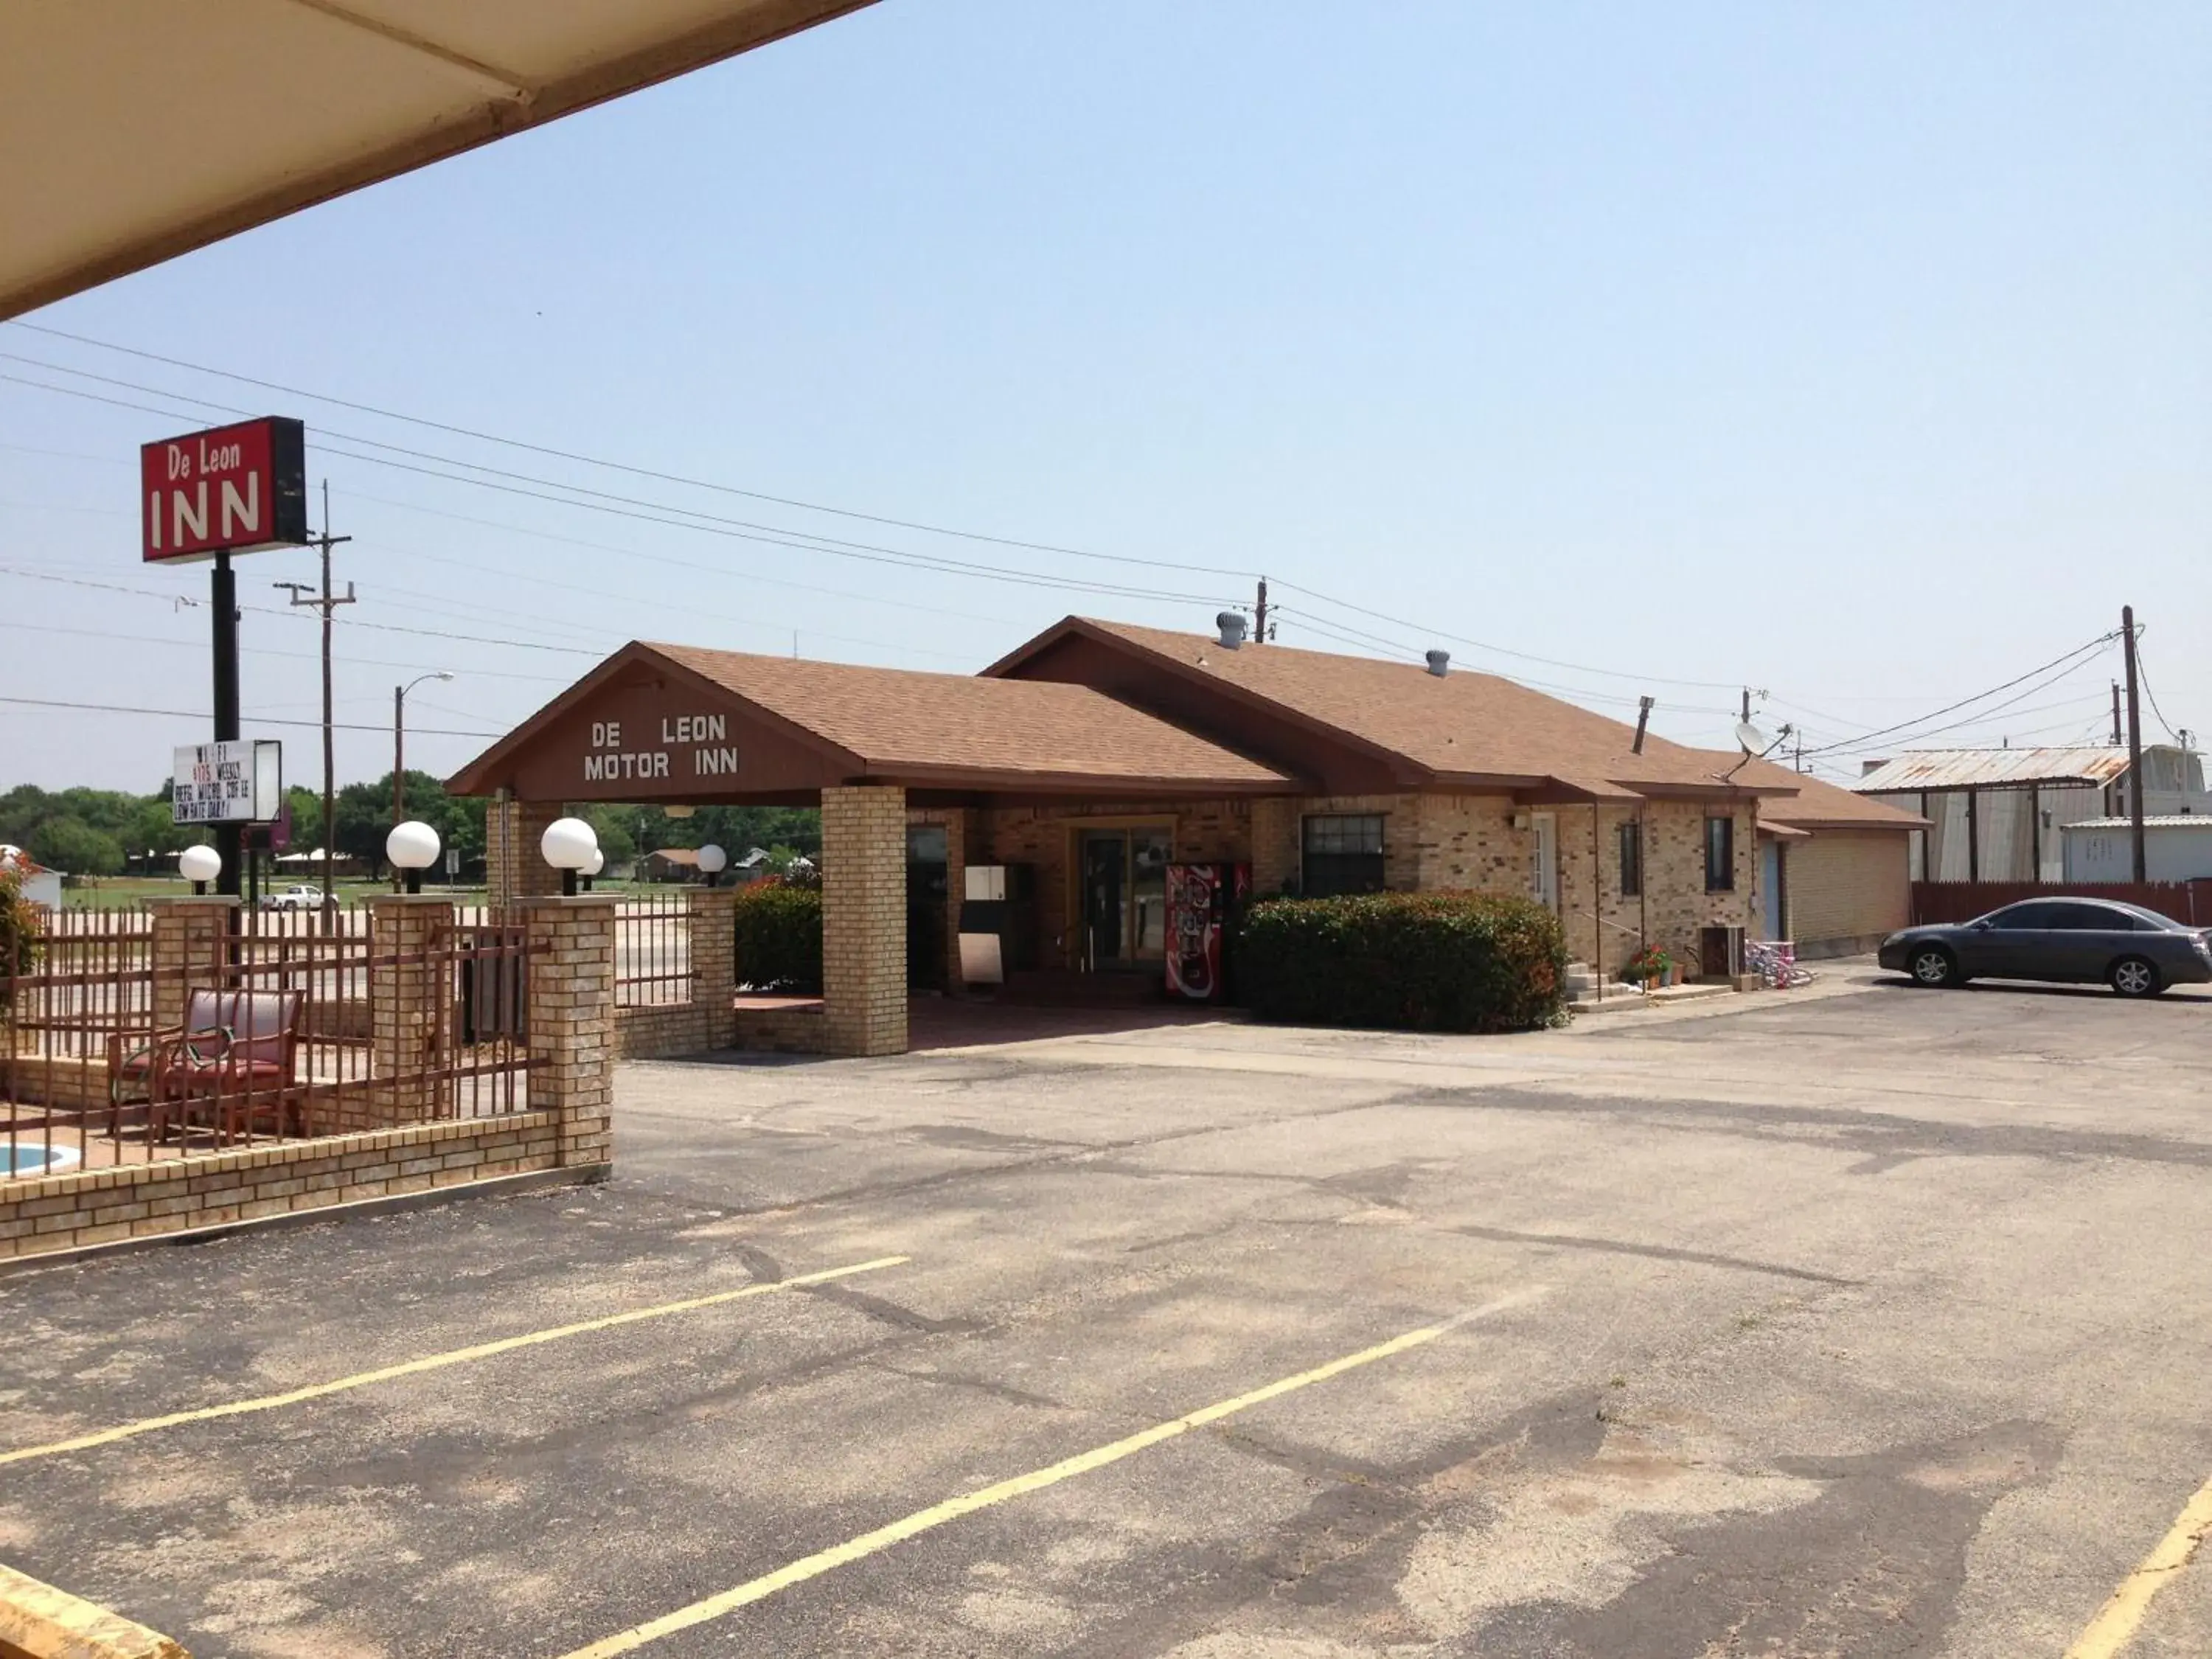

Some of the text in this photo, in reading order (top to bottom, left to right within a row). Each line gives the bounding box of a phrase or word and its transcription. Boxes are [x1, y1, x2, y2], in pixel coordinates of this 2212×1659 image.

[168, 438, 240, 481] De Leon
[151, 471, 258, 549] INN
[592, 714, 726, 747] DE LEON
[215, 761, 240, 780] WEEKLY
[585, 748, 737, 781] MOTOR INN
[173, 804, 189, 820] LOW
[189, 801, 206, 818] RATE
